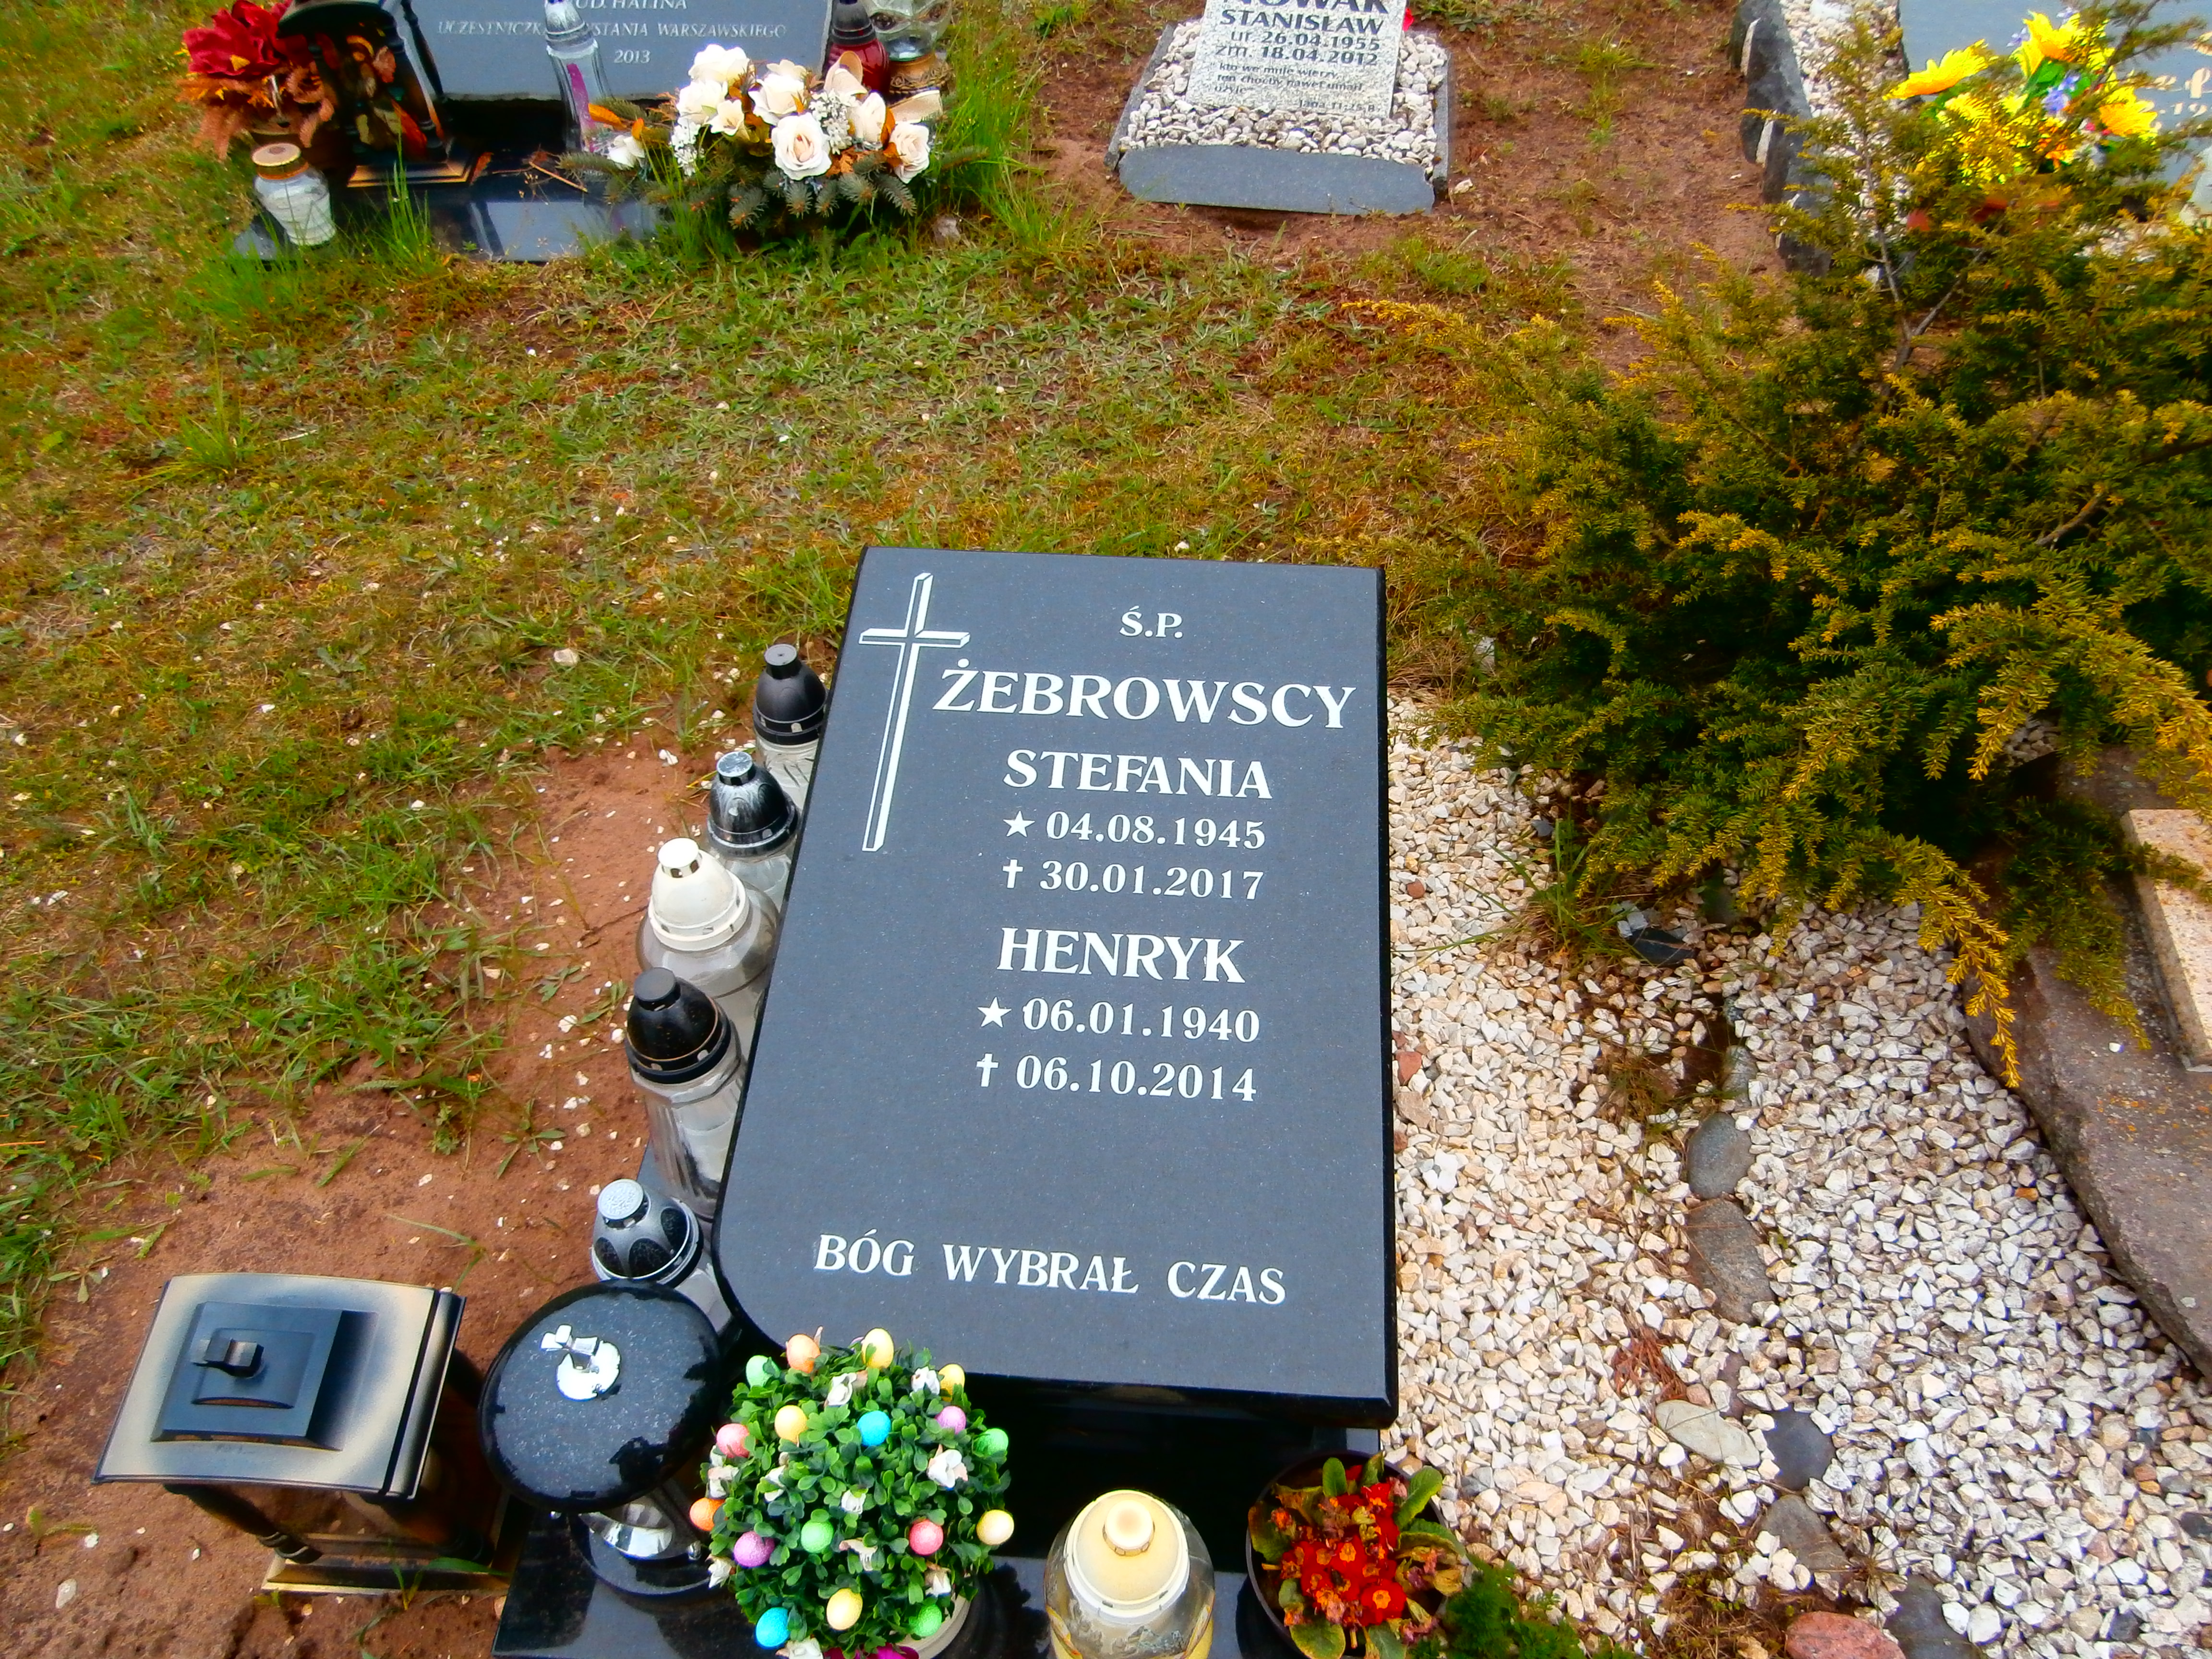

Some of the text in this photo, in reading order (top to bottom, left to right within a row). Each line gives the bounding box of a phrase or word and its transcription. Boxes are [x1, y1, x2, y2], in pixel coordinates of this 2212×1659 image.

[591, 23, 649, 37] STANIA
[657, 22, 786, 38] WARSZAWSKIEGO
[1220, 9, 1384, 35] STANISŁAW
[1262, 31, 1381, 51] 26.04.1955
[614, 49, 651, 64] 2013
[1262, 46, 1378, 66] 18.04.2012
[1119, 605, 1183, 638] Ś.P.
[932, 658, 1357, 729] ŻEBROWSCY
[1003, 749, 1273, 799] STEFANIA
[1046, 811, 1265, 849] 04.08.1945
[1039, 861, 1264, 900] 30.01.2017
[996, 927, 1246, 984] HENRYK
[1022, 998, 1260, 1043] 06.01.1940
[1016, 1055, 1257, 1102] 06.10.2014
[813, 1229, 1286, 1305] BÓG WYBRAŁ CZAS
